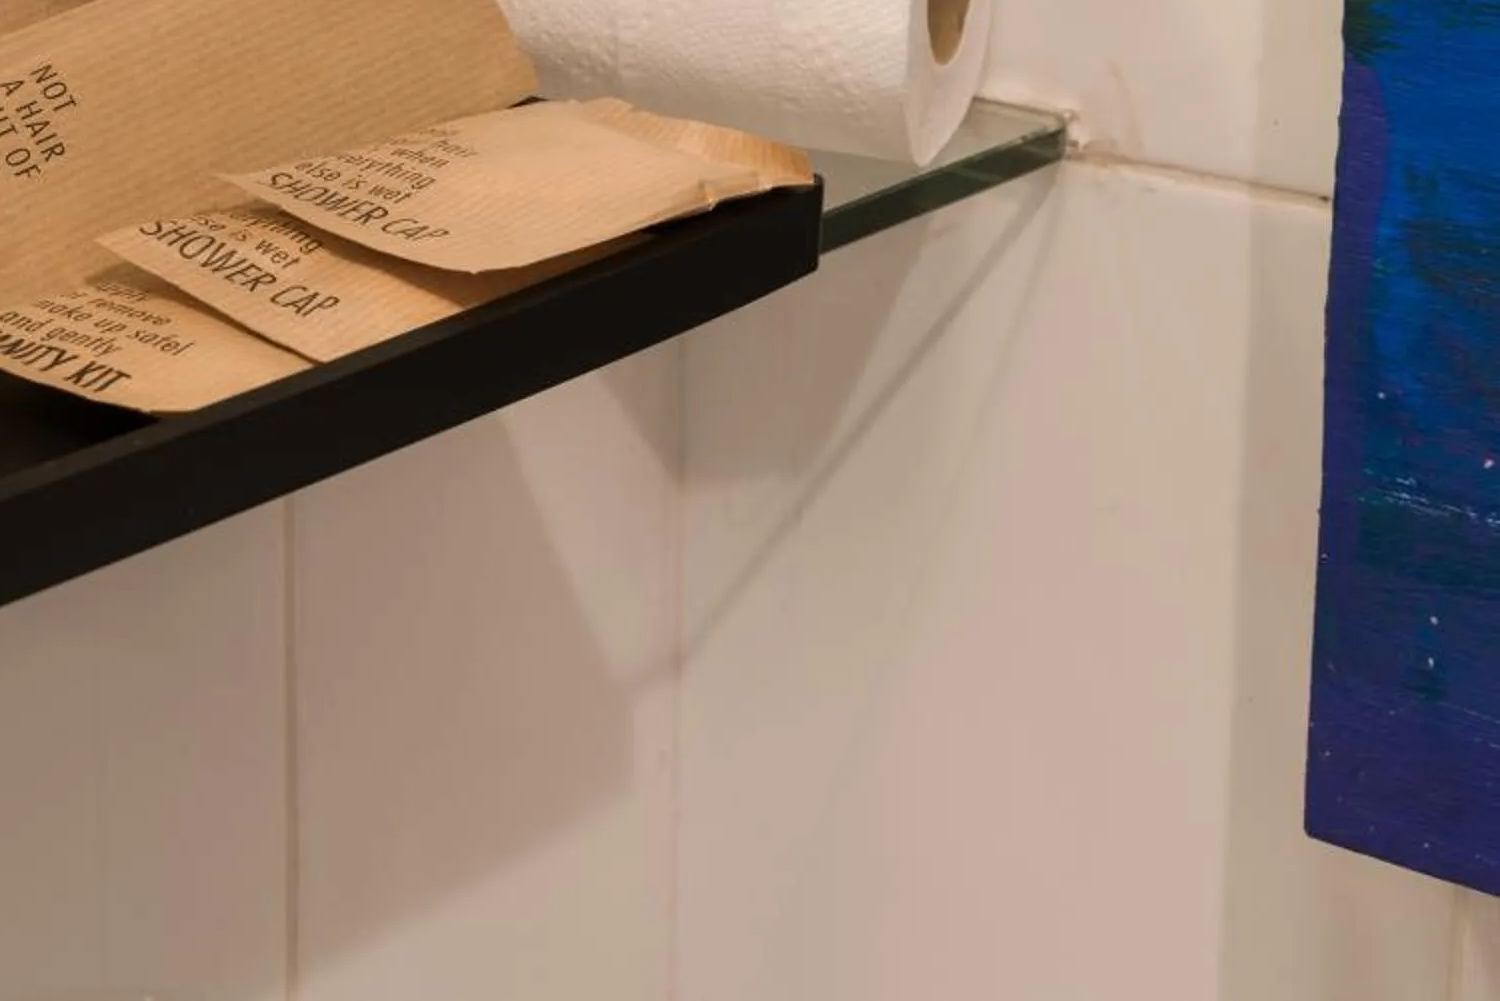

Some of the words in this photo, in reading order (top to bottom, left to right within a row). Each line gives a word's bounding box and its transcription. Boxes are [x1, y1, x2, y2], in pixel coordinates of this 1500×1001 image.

[30, 64, 77, 112] NOT
[0, 80, 25, 97] A
[15, 100, 66, 162] HAIR
[5, 148, 42, 178] OF
[270, 171, 389, 227] SHOWER
[380, 217, 451, 242] CAP
[139, 220, 277, 293] SHOWER
[269, 285, 341, 318] CAP
[254, 239, 302, 270] wet
[0, 310, 52, 333] and
[39, 325, 123, 357] gently
[93, 318, 127, 336] up
[64, 359, 132, 394] KIT
